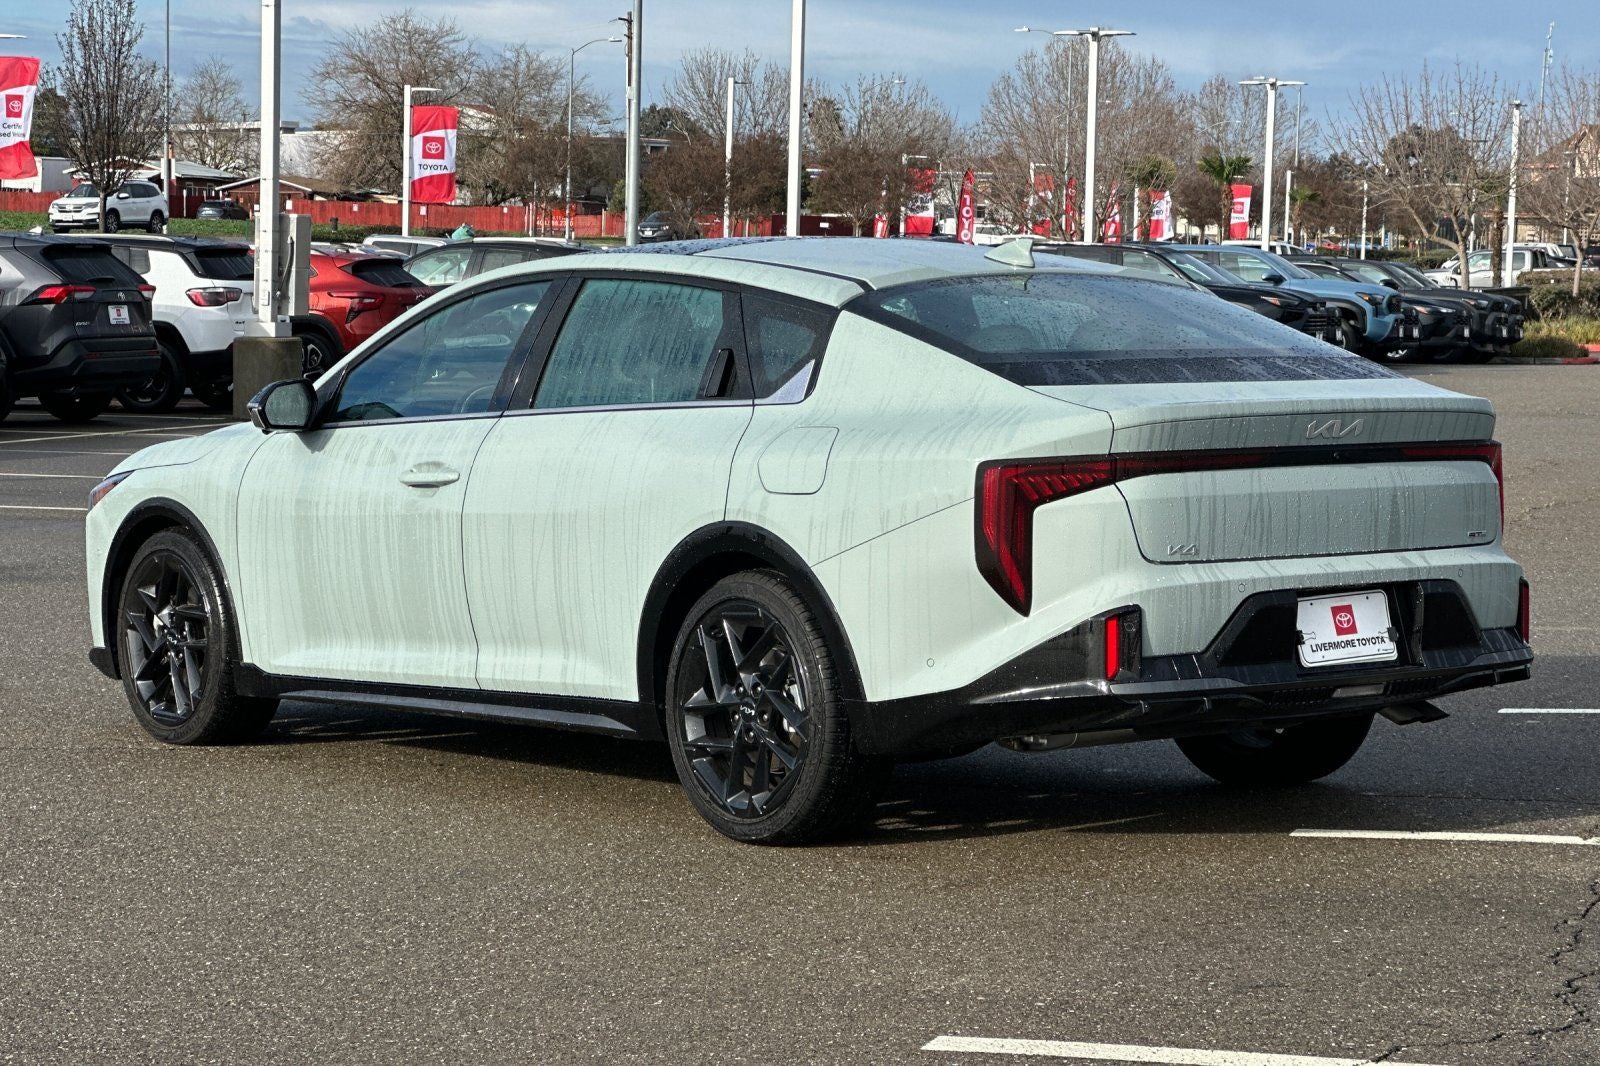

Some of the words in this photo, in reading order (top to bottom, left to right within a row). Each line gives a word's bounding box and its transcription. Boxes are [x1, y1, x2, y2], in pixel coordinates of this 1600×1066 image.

[961, 194, 972, 244] TOYO
[1305, 418, 1364, 439] KIA
[1167, 543, 1198, 556] K4
[1310, 640, 1357, 653] LIVERMORE
[1356, 636, 1387, 648] TOYOTA
